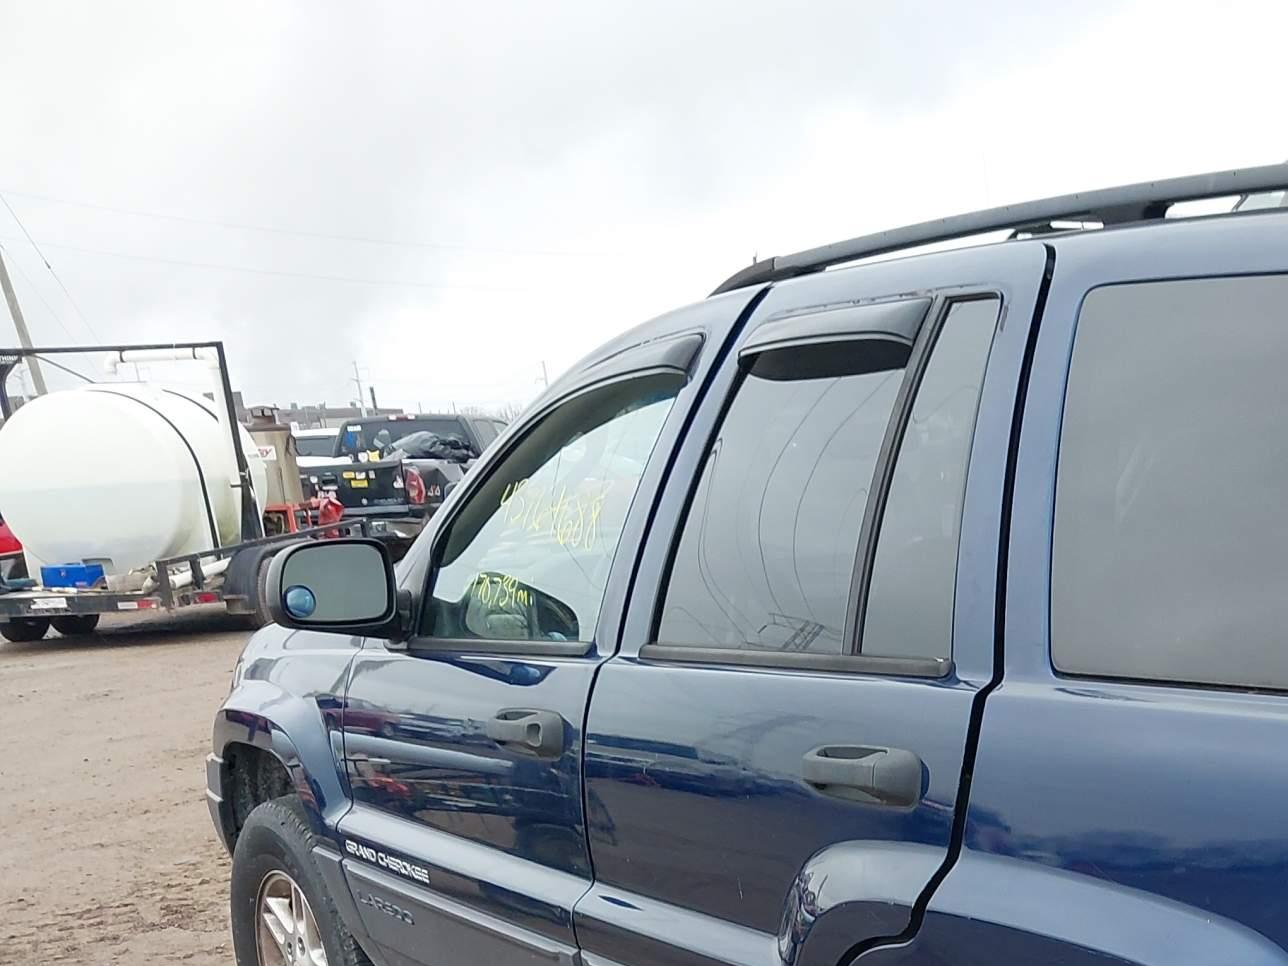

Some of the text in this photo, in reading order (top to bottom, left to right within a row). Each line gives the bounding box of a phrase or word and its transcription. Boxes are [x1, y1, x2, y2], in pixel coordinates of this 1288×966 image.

[344, 839, 431, 884] GRAND CHEROKEE
[356, 888, 415, 926] LAREDO
